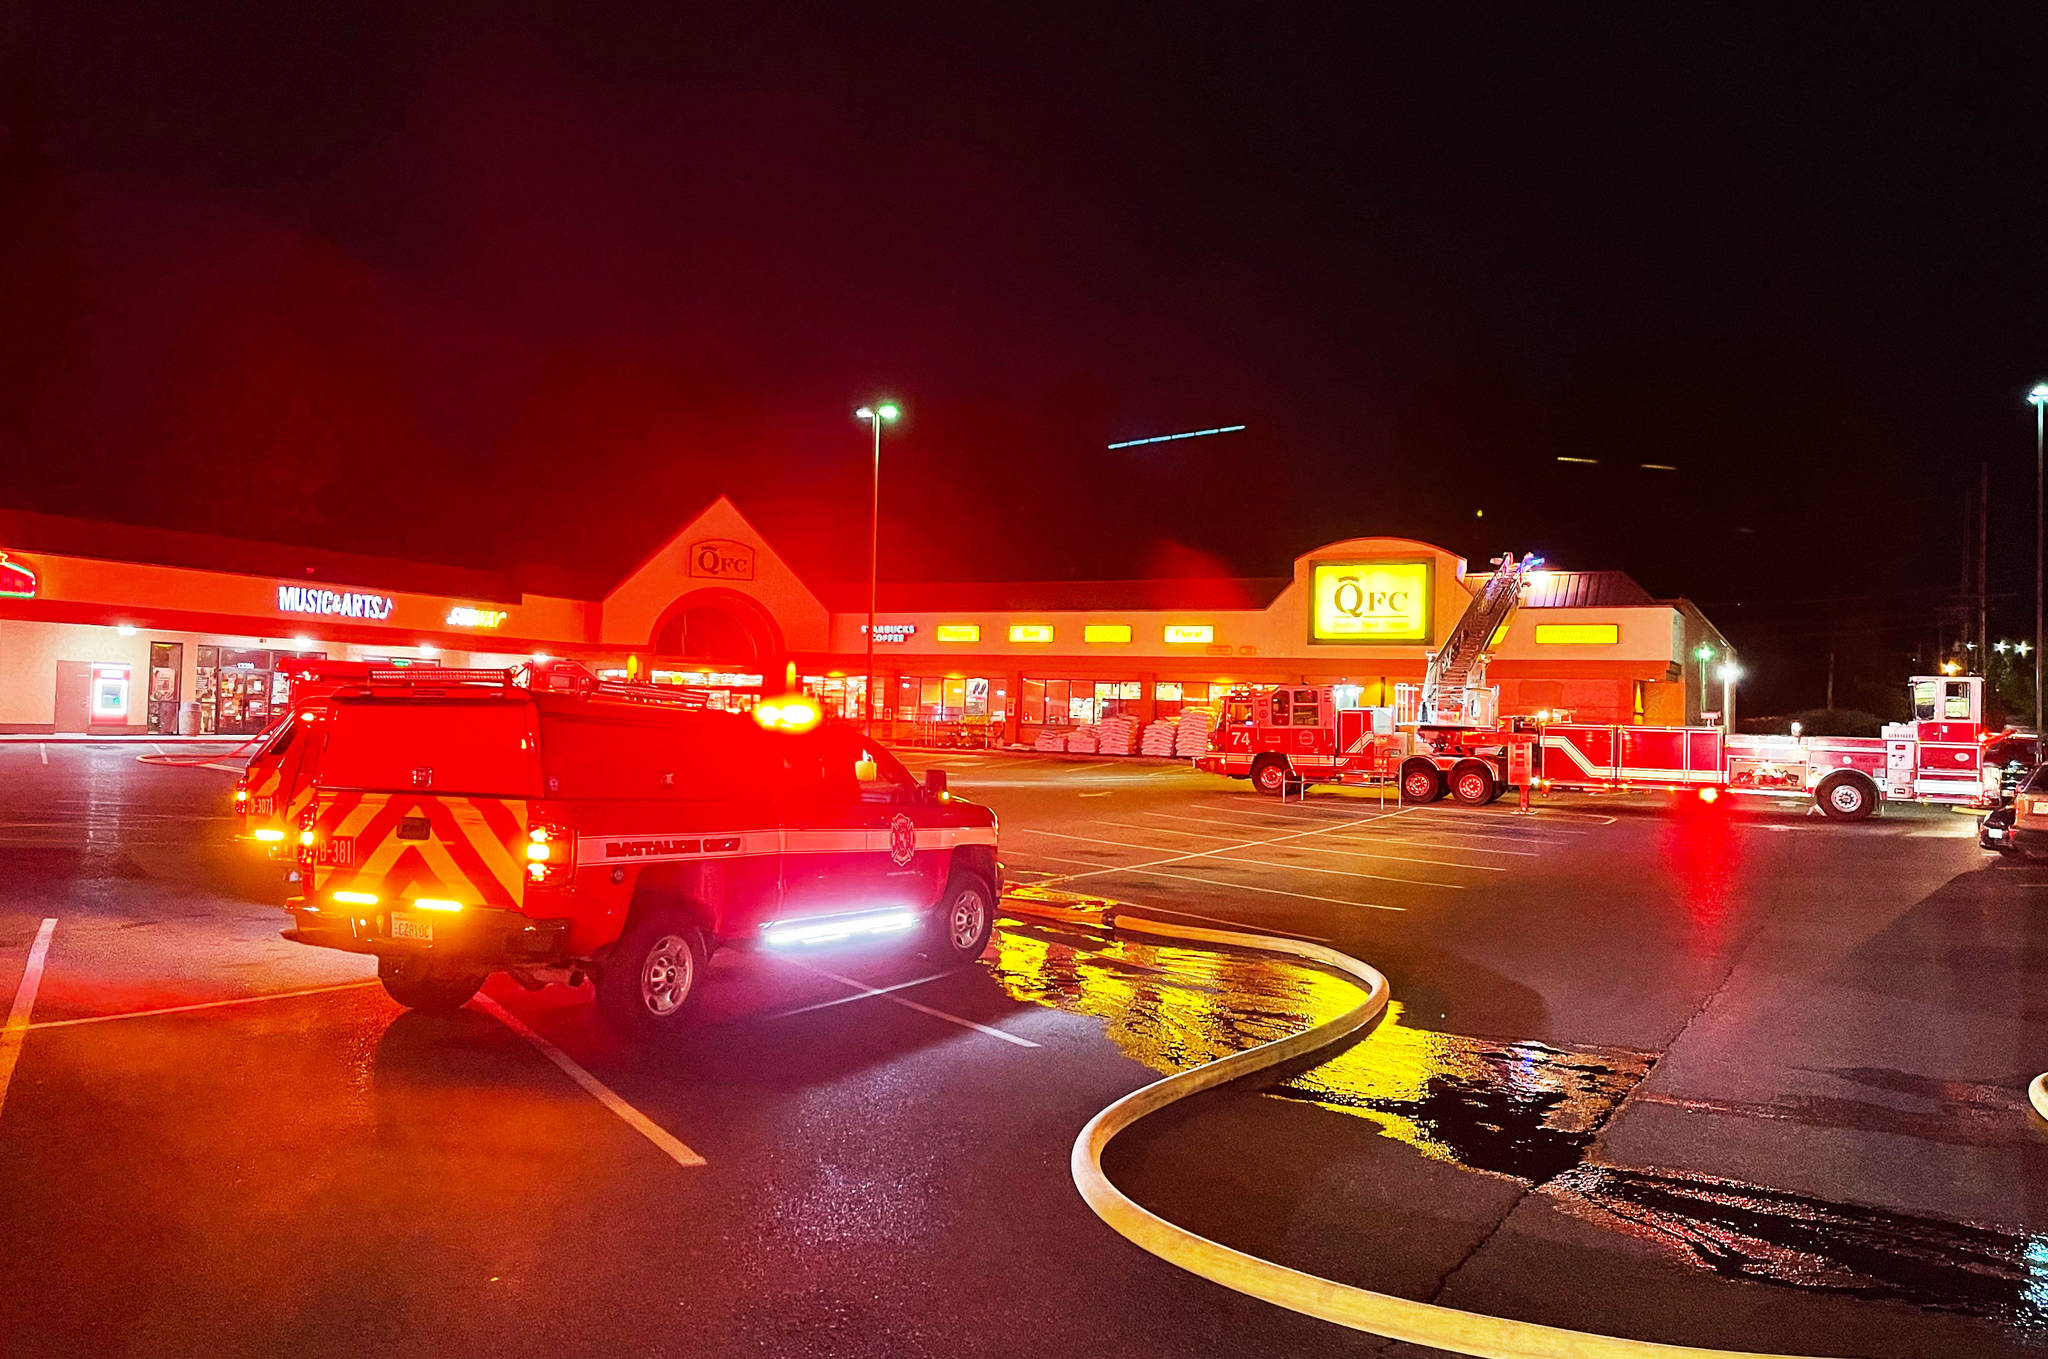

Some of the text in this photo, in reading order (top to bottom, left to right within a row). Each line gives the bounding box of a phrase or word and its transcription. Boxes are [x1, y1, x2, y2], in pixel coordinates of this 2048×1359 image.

[698, 549, 748, 575] QFC
[279, 586, 383, 619] MUSIC&ARTS
[1334, 582, 1408, 617] QFC
[860, 625, 915, 634] SARBUCKS
[1231, 731, 1250, 746] 74
[320, 839, 351, 864] B-381
